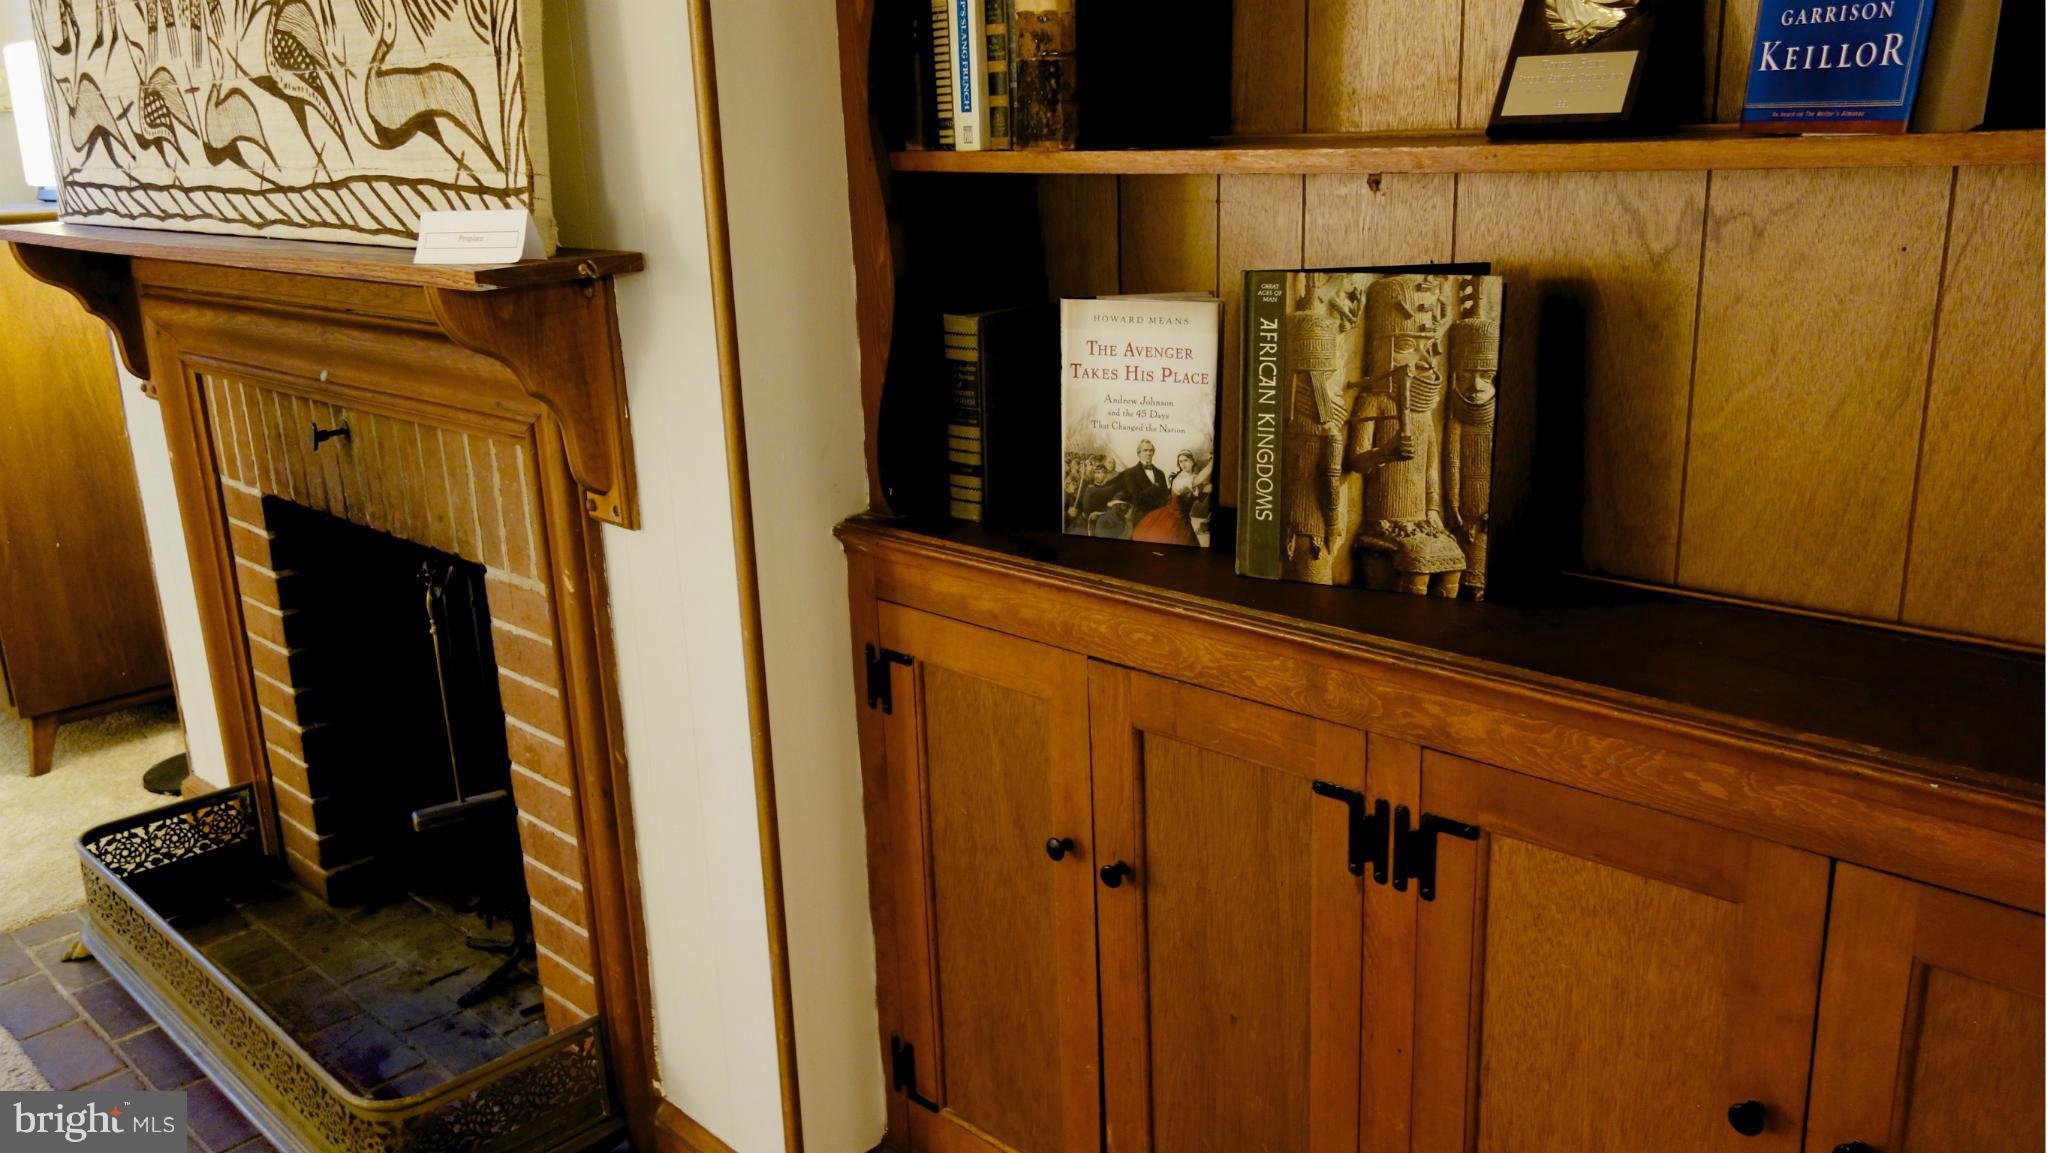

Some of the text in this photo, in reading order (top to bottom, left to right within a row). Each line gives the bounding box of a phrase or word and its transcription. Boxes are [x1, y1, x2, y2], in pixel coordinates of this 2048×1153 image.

[1781, 1, 1896, 26] GARRISON
[960, 18, 968, 59] SLANG
[1757, 32, 1905, 72] KEILLOR
[962, 61, 970, 110] FRENCH
[1093, 314, 1190, 326] HOWARD MEANS
[1086, 340, 1194, 360] THE AVENGER
[1070, 363, 1209, 385] TAKES HIS PLACE
[1103, 394, 1174, 407] Andrew Johnson
[1107, 408, 1169, 420] and the 45 Days
[1255, 317, 1278, 521] AFRICAN KINGDOMS
[1091, 419, 1186, 434] That Changed the Nation
